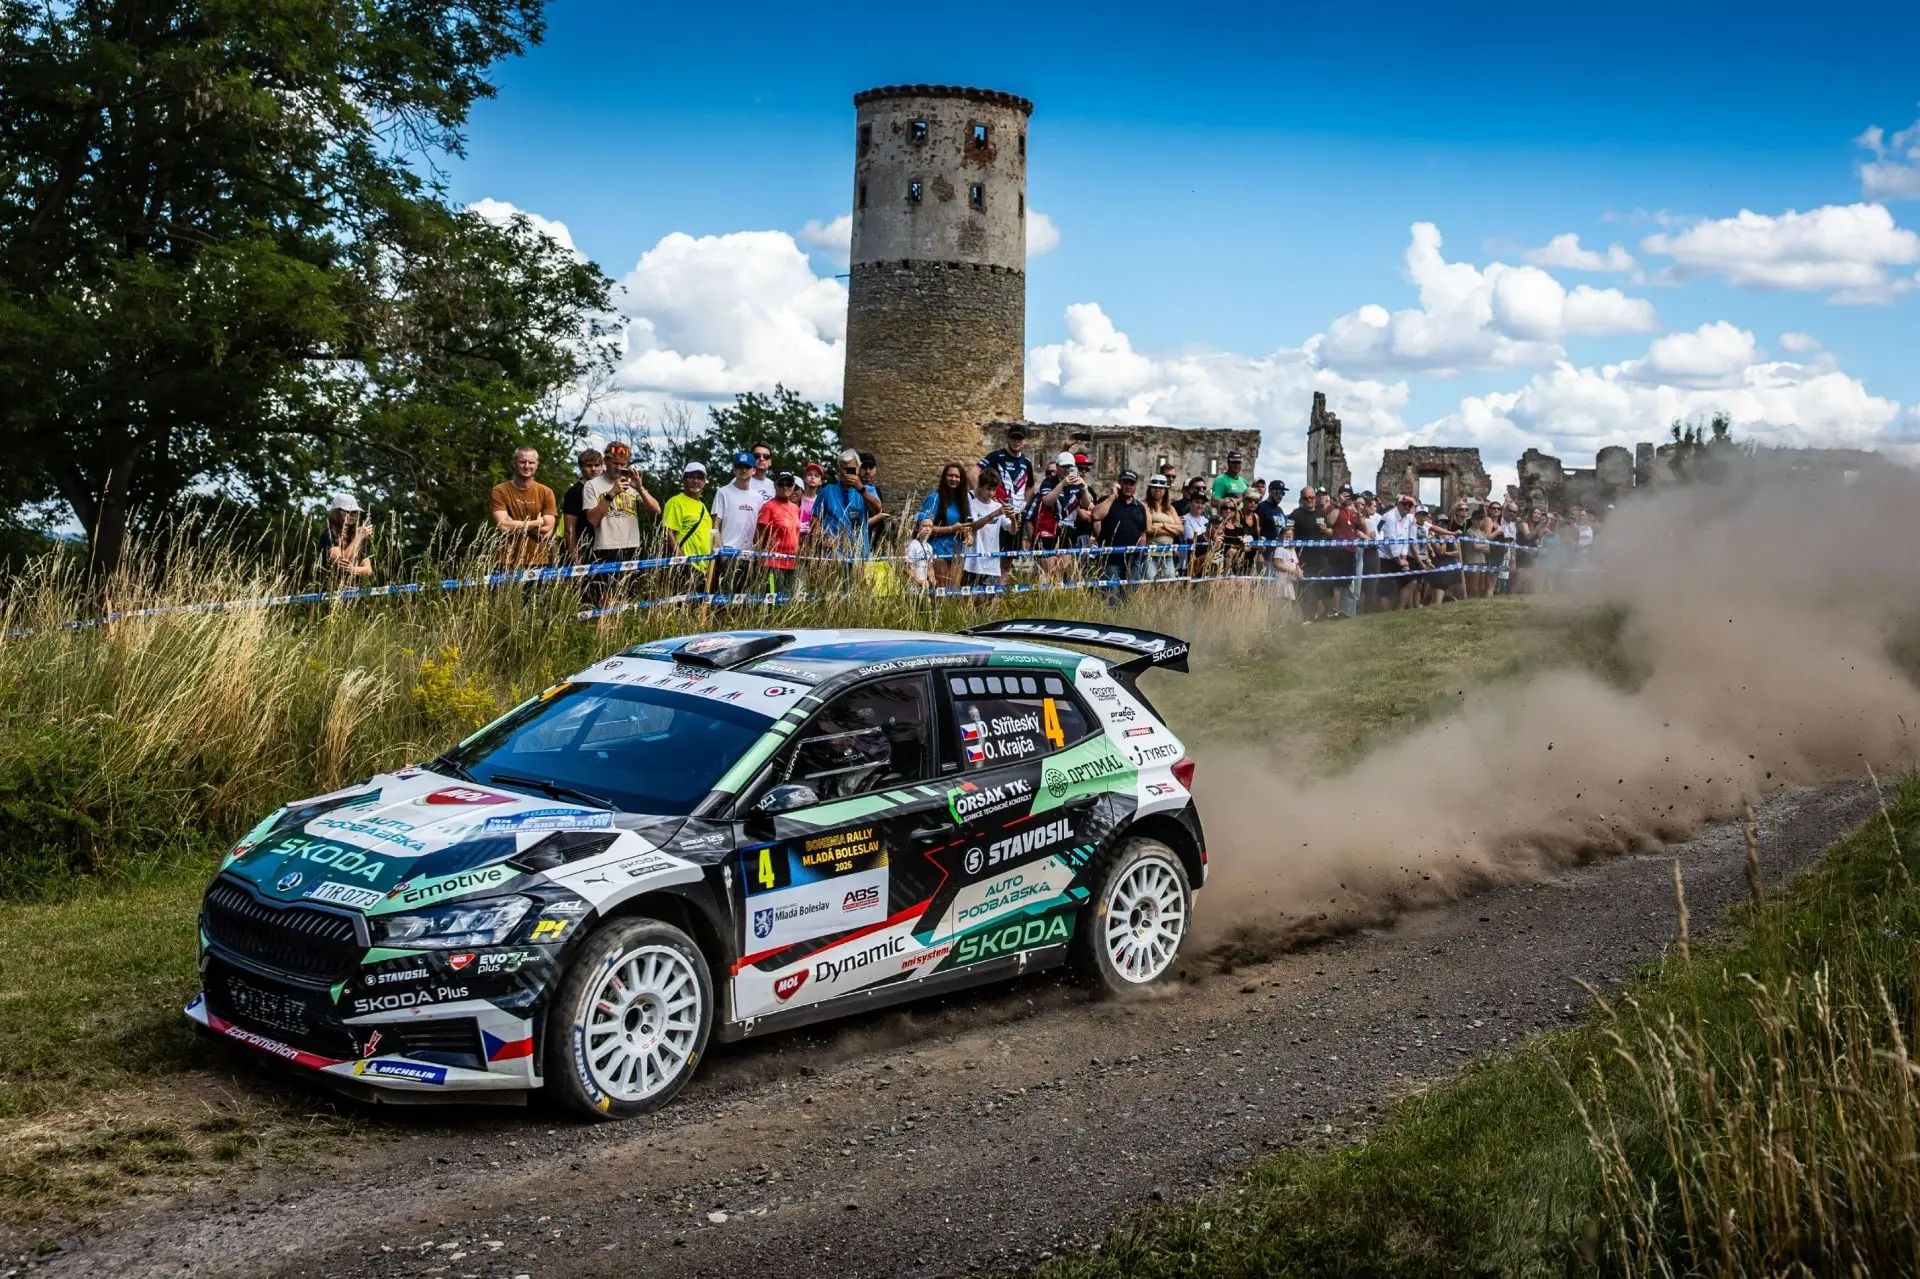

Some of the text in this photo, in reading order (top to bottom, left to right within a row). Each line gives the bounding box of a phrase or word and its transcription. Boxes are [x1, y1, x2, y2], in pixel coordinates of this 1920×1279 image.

[978, 712, 1040, 738] D. Stříteský
[1043, 697, 1065, 748] 4
[984, 735, 1036, 760] O. Krajča
[1067, 753, 1124, 785] OPTIMAL
[956, 785, 1007, 815] ORSÁK
[962, 810, 984, 823] STANICE
[982, 801, 1010, 816] TECHNICKÉ
[363, 816, 416, 831] AUTO
[846, 828, 873, 844] RALLY
[988, 817, 1075, 867] STAVOSIL
[802, 840, 880, 866] MLADÁ BOLESLAV
[757, 848, 776, 890] 4
[834, 860, 854, 873] 2026
[403, 868, 502, 904] Emotive
[843, 884, 881, 905] ABS
[984, 873, 1025, 899] AUTO
[341, 889, 380, 907] 0773
[957, 881, 1052, 924] PODBABSKÁ
[774, 906, 799, 922] Mladá
[798, 900, 831, 917] Boleslav
[529, 918, 570, 940] P1
[477, 963, 501, 974] plus
[479, 952, 508, 965] EVO
[814, 935, 906, 984] Dynamic
[377, 967, 430, 985] STAVOSIL
[777, 974, 800, 993] MOL
[437, 985, 470, 1001] Plus
[388, 1065, 447, 1080] MICHELIN
